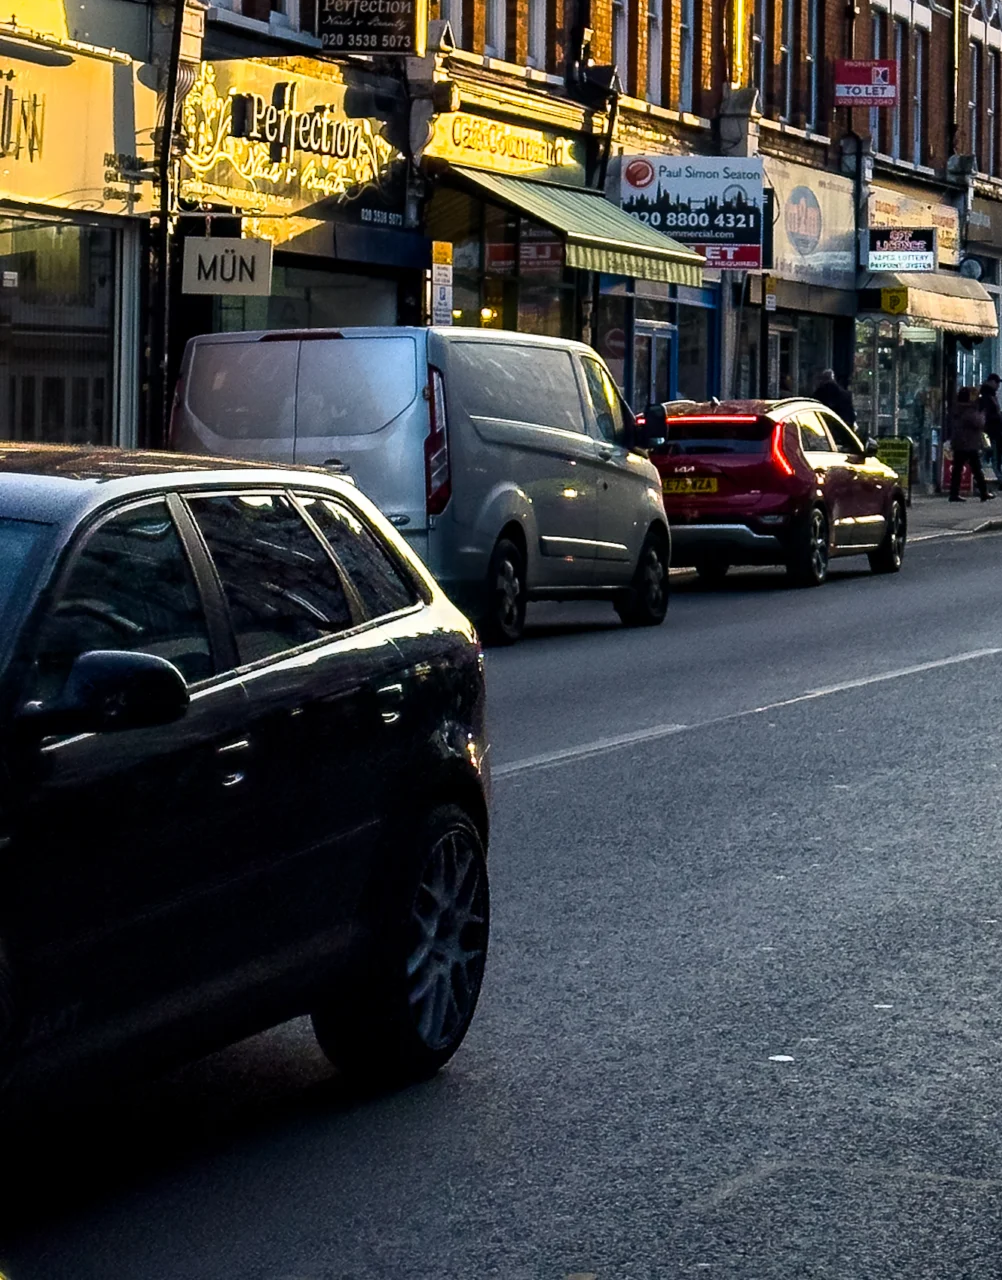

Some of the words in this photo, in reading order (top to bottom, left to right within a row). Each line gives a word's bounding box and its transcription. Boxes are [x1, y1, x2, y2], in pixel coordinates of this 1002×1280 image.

[321, 33, 344, 46] 020
[348, 34, 377, 47] 3538
[382, 35, 411, 48] 5073
[844, 86, 862, 96] TO
[865, 86, 887, 96] LET
[250, 81, 362, 163] Perfection
[658, 165, 682, 179] Paul
[685, 165, 719, 179] Simon
[722, 166, 760, 180] Seaton
[666, 212, 710, 227] 8800
[714, 213, 755, 228] 4321
[660, 229, 735, 239] commercial.com
[197, 248, 256, 282] MÜN
